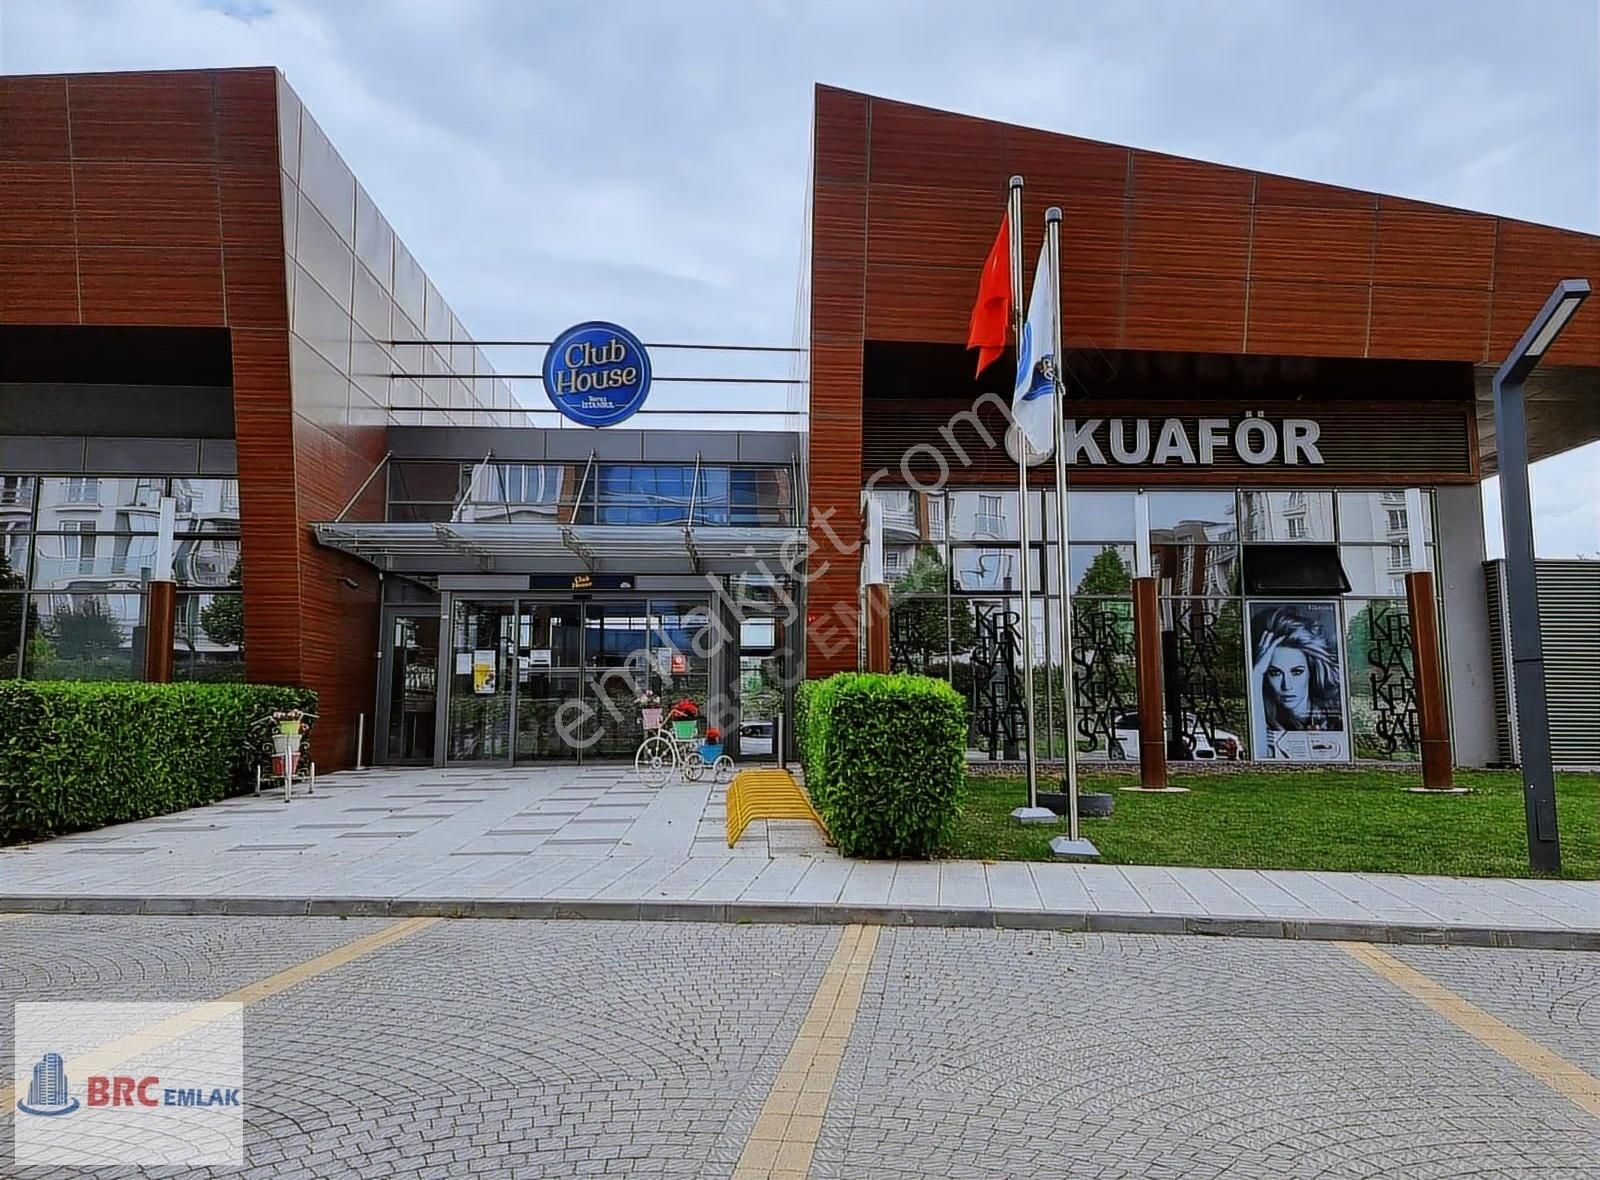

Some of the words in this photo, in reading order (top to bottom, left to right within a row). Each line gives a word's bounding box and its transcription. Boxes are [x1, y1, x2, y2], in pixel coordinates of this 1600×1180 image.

[565, 339, 626, 367] Club
[557, 367, 637, 394] House
[1063, 410, 1325, 465] KUAFÖR
